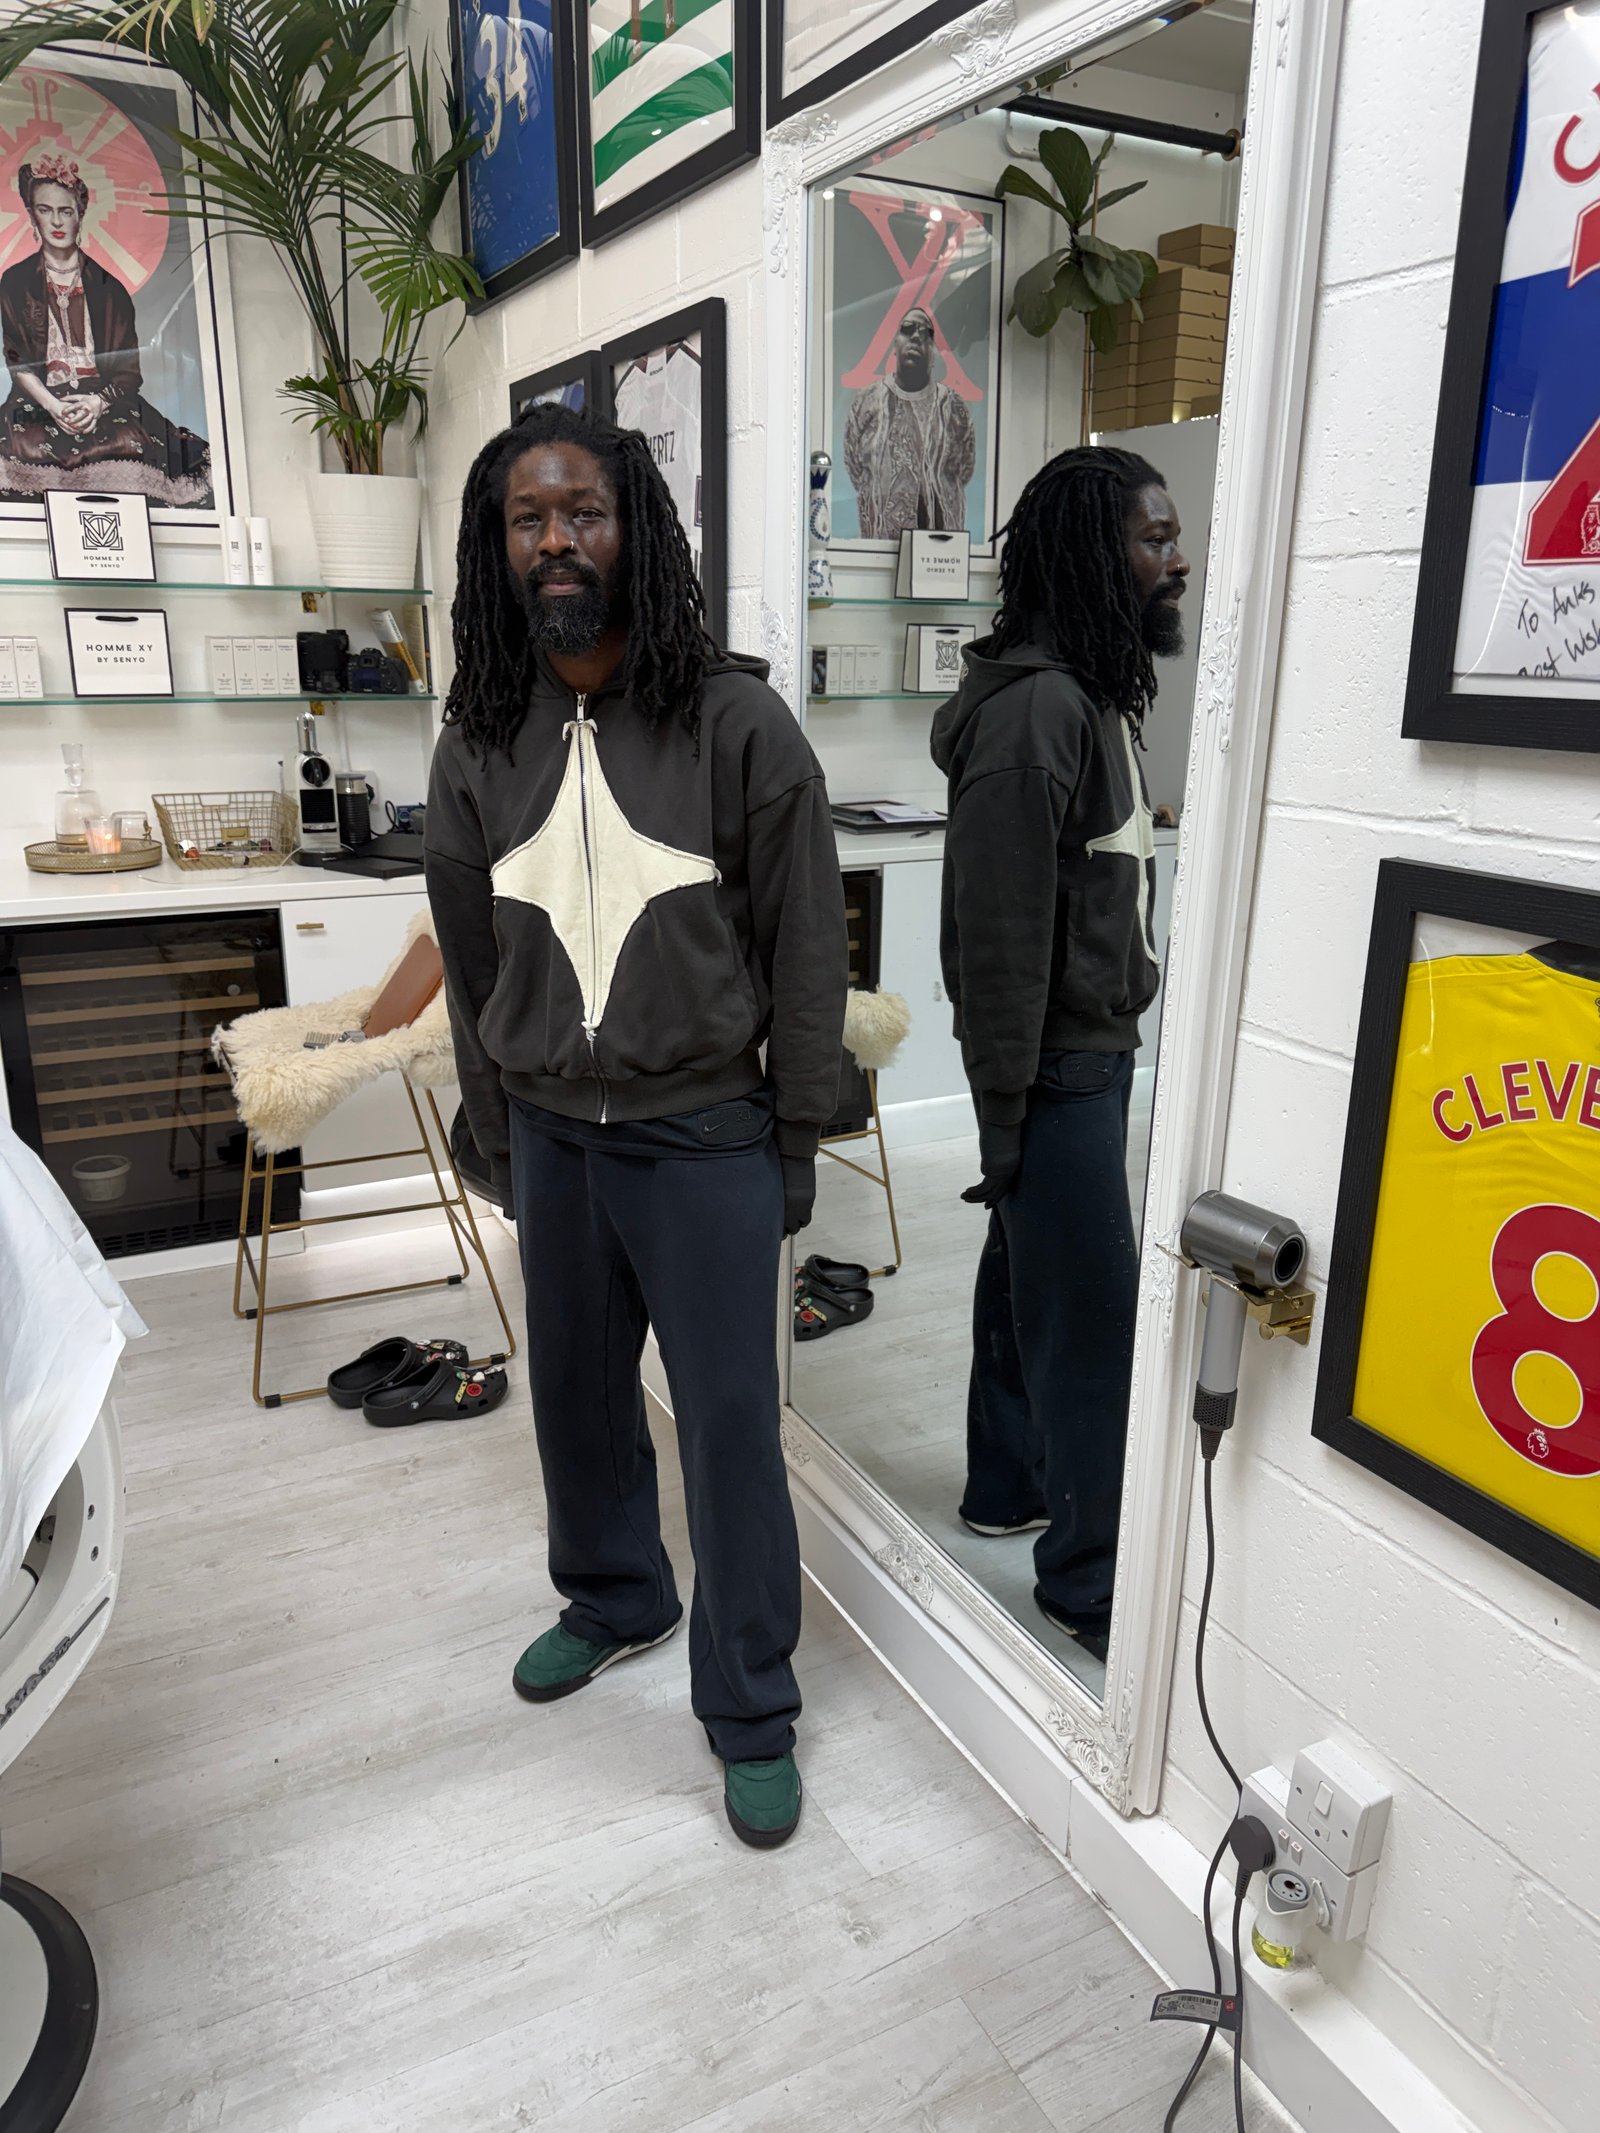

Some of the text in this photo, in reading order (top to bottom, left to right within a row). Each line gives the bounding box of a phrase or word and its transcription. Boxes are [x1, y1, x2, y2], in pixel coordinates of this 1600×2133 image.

[1517, 598, 1539, 639] To
[86, 644, 153, 652] HOMME XY
[1470, 1202, 1600, 1478] 8
